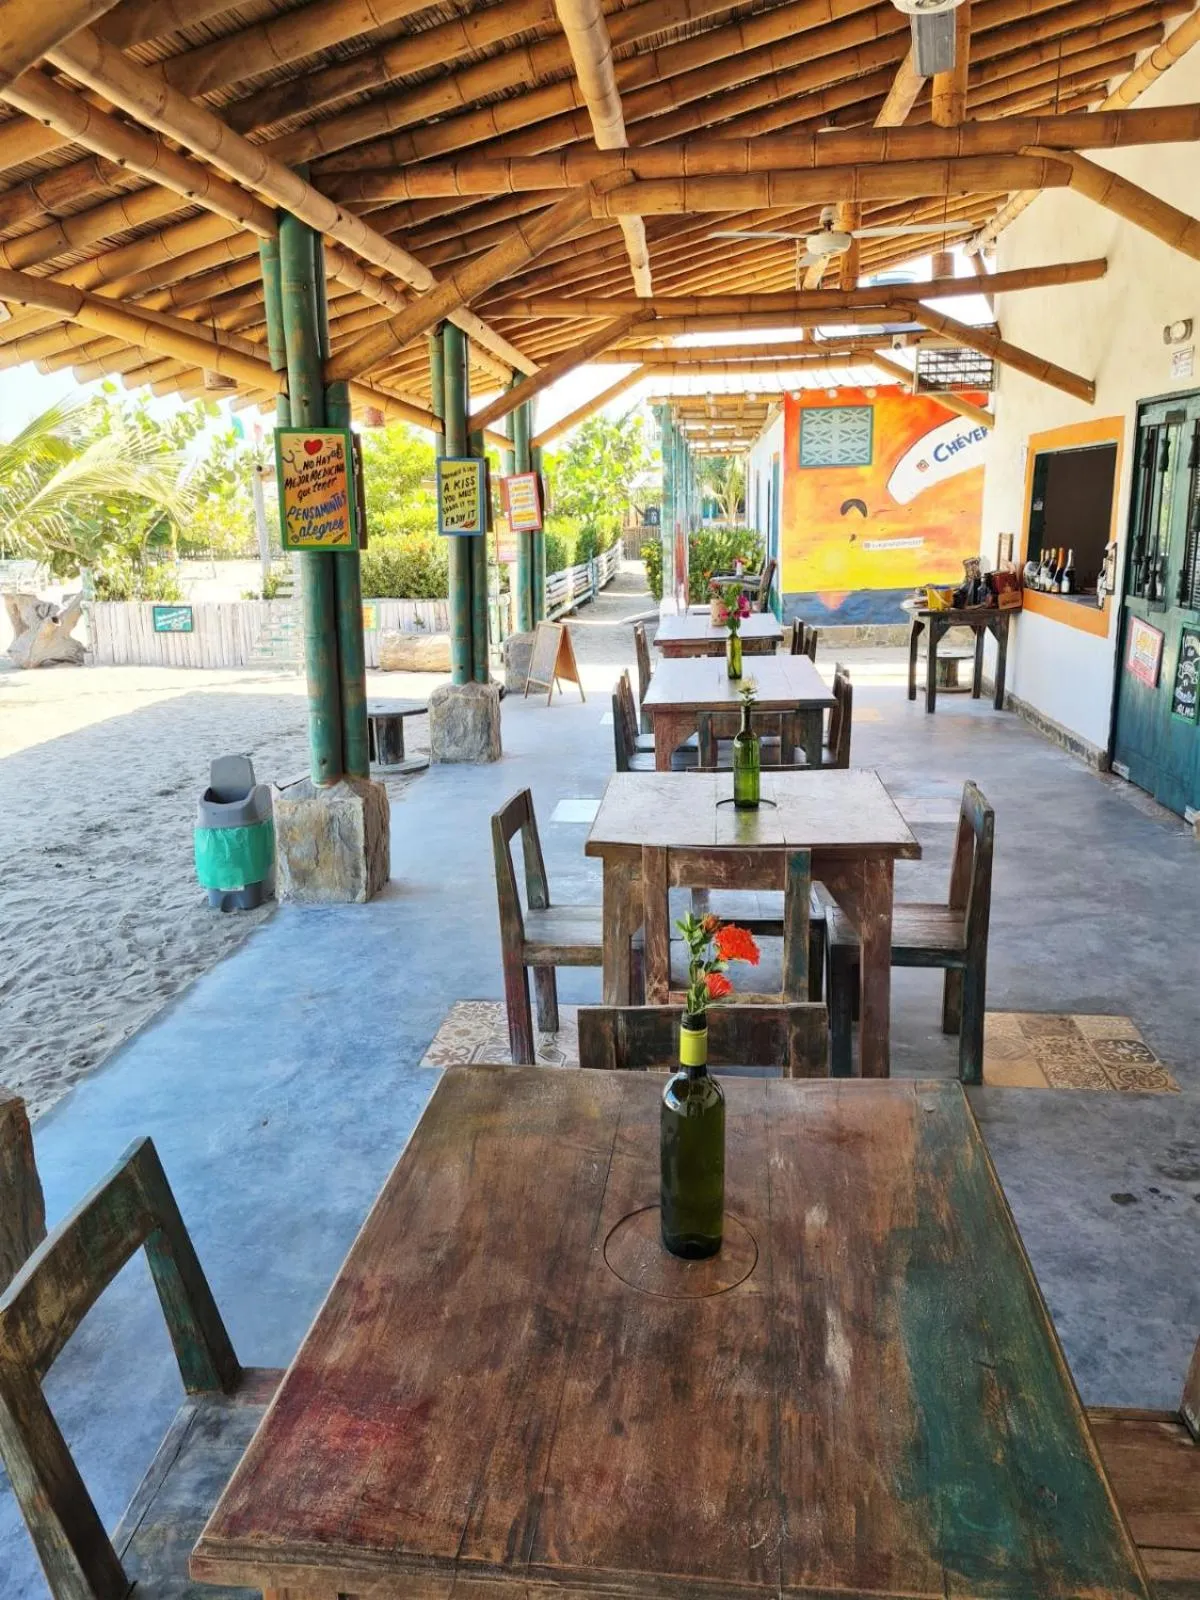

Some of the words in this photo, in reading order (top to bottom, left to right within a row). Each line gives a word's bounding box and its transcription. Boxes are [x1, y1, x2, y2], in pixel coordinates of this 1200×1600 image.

[303, 460, 315, 470] NO
[316, 455, 331, 467] HAY
[444, 482, 450, 492] A
[454, 476, 475, 490] KISS
[443, 495, 456, 503] YOU
[459, 488, 476, 498] MUST
[445, 513, 465, 526] ENJOY
[468, 510, 476, 519] IT
